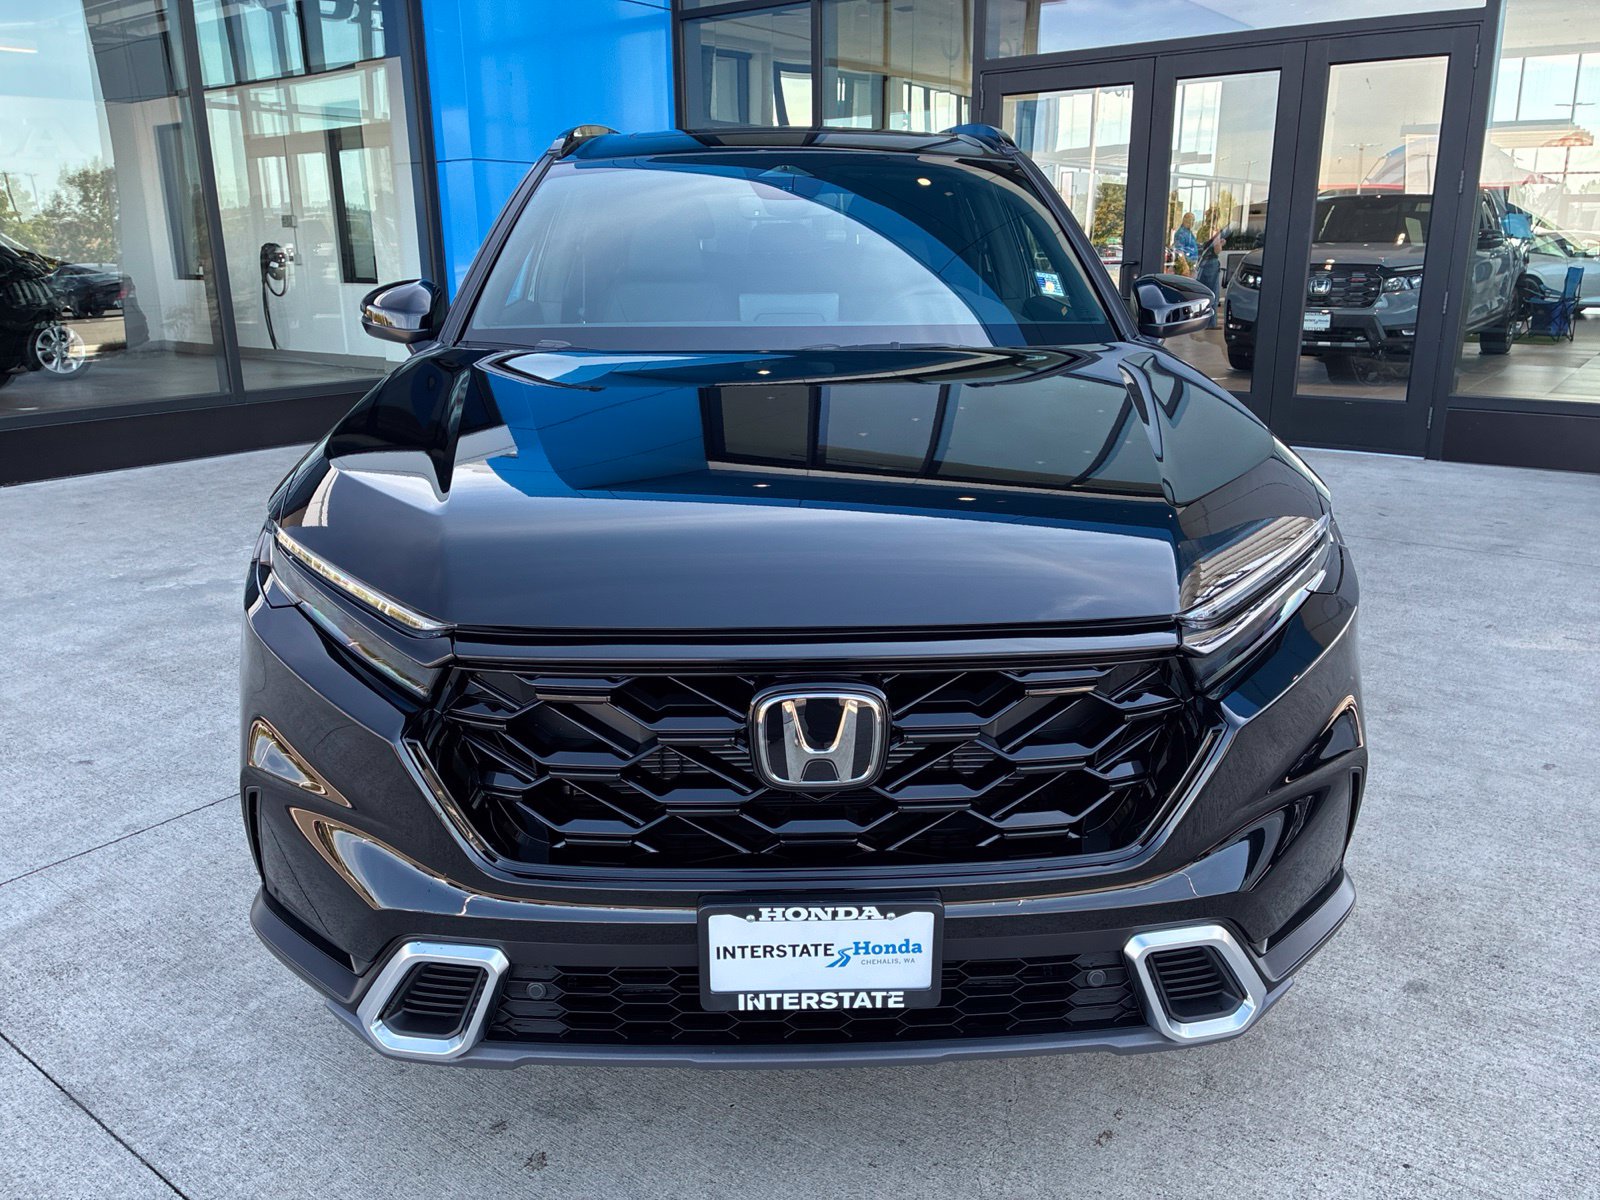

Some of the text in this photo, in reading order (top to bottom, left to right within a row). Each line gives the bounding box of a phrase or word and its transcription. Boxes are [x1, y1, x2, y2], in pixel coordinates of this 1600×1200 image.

[758, 907, 884, 921] HONDA
[716, 938, 923, 960] INTERSTATE Honda
[861, 957, 915, 966] CHEHALIS, WA
[738, 991, 905, 1010] INTERSTATE
